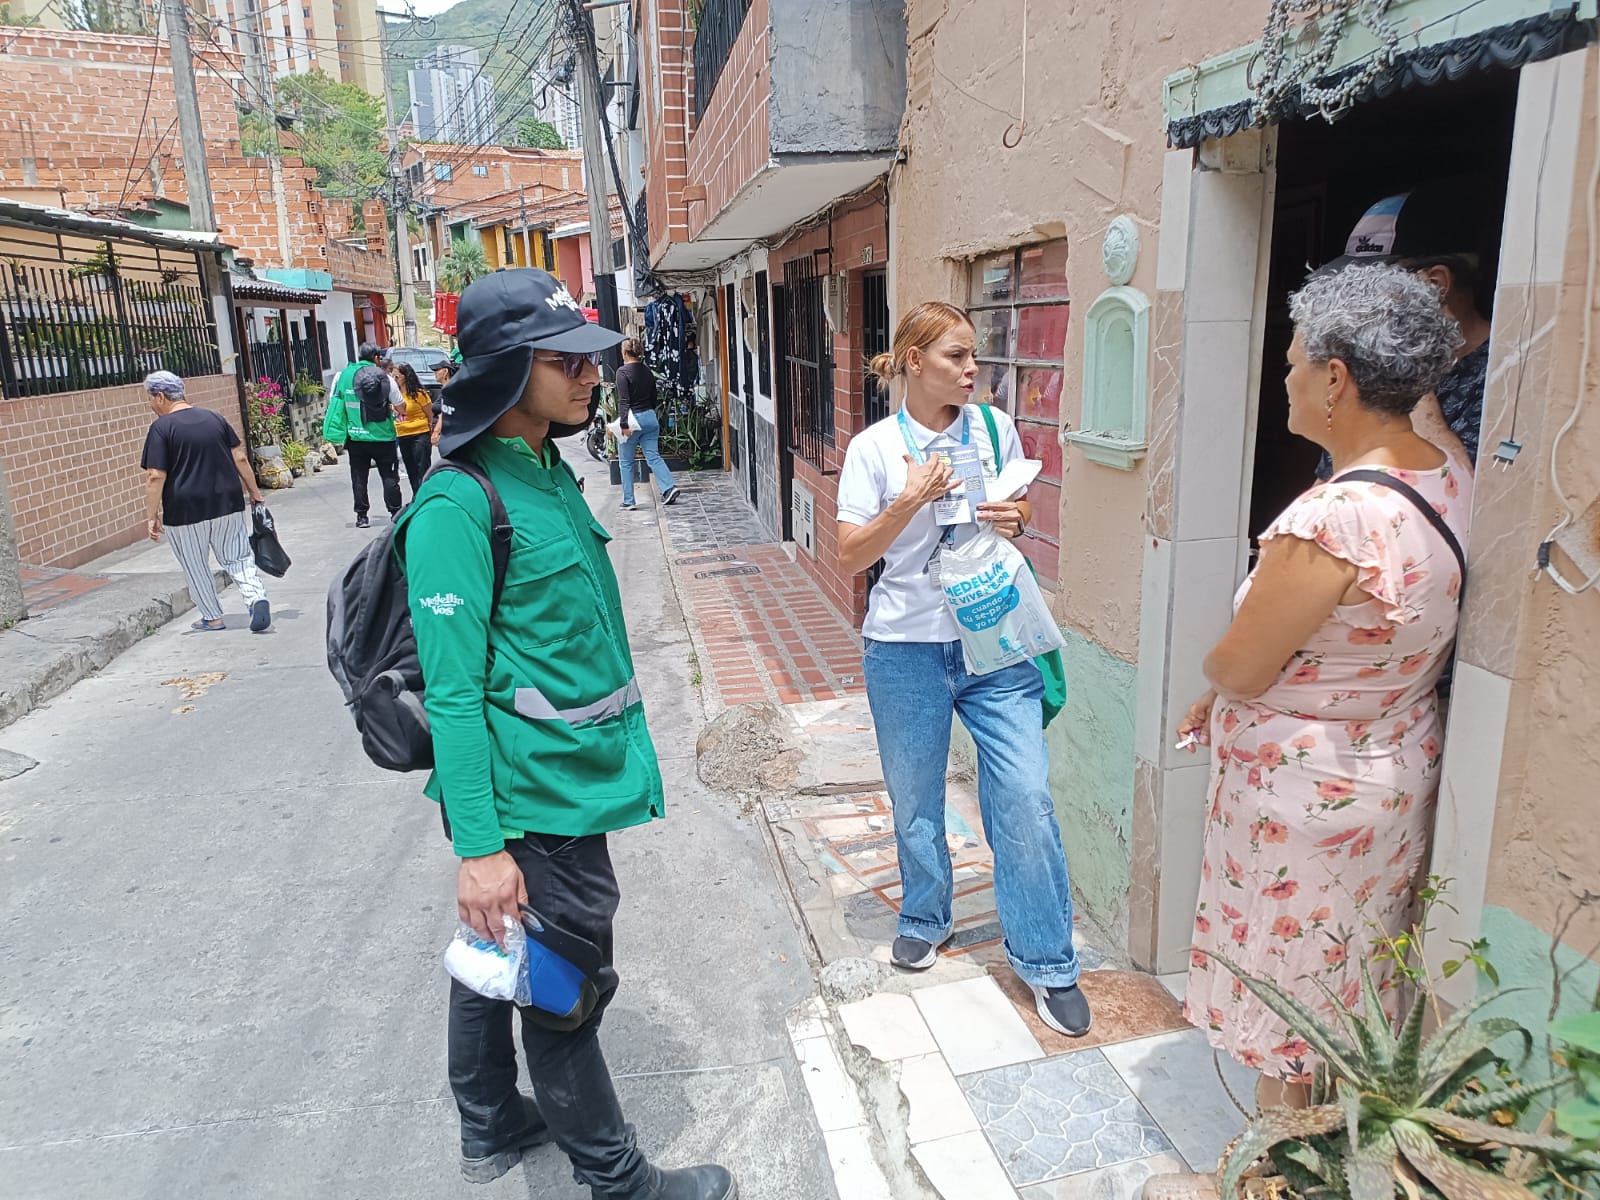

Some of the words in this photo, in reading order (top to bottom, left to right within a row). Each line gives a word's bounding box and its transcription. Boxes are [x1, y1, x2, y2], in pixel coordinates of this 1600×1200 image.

[419, 592, 464, 609] Medellín
[959, 590, 984, 604] VIVE
[432, 605, 455, 616] Vos
[971, 596, 1003, 614] cuando
